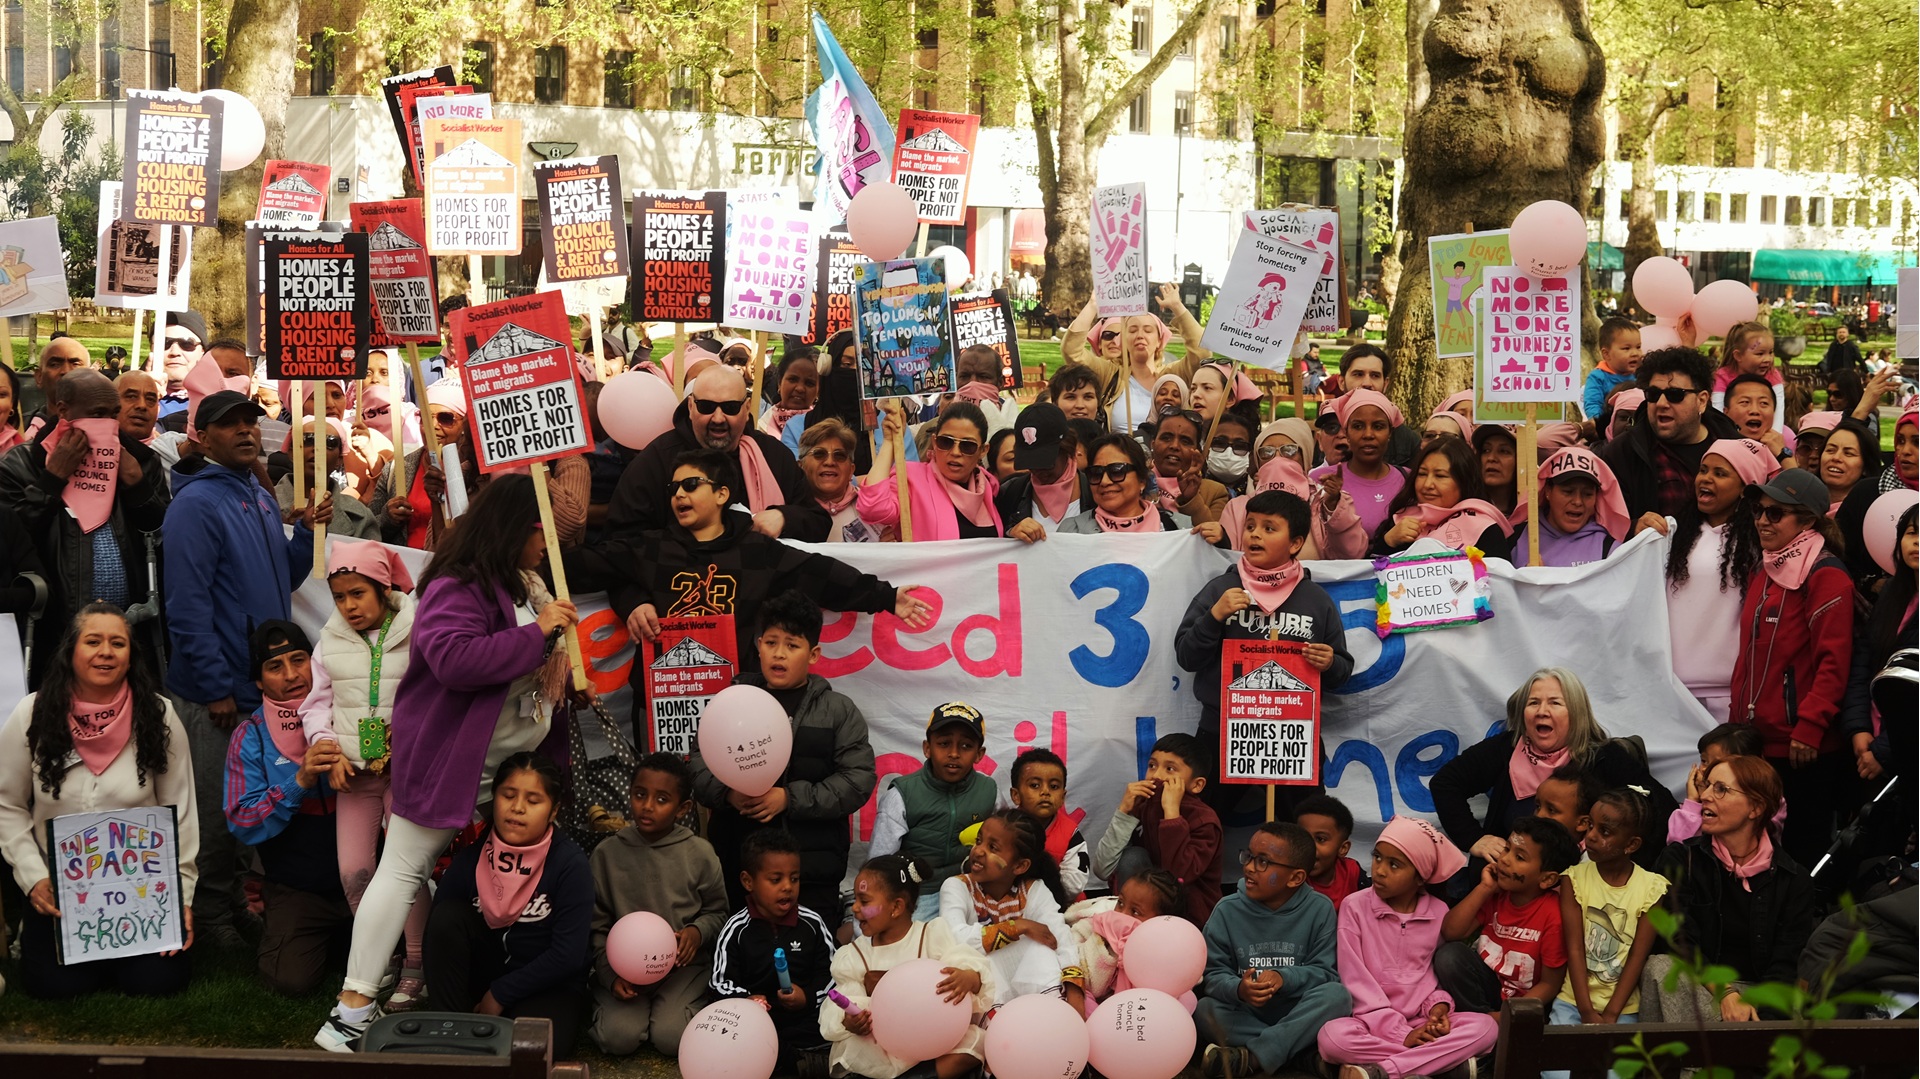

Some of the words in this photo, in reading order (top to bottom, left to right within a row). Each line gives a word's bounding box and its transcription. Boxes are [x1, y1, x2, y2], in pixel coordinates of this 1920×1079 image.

[450, 105, 484, 119] MORE
[140, 114, 196, 133] HOMES
[138, 130, 210, 153] PEOPLE
[137, 150, 164, 162] NOT
[165, 152, 208, 166] PROFIT
[137, 162, 206, 181] COUNCIL
[136, 178, 206, 196] HOUSING
[548, 179, 598, 197] HOMES
[898, 173, 935, 189] HOMES
[939, 178, 958, 190] FOR
[150, 194, 188, 209] RENT
[939, 191, 959, 203] NOT
[1099, 187, 1126, 200] SOCIAL
[436, 199, 478, 212] HOMES
[485, 199, 507, 212] FOR
[550, 192, 612, 214] PEOPLE
[655, 200, 680, 208] Homes
[919, 203, 955, 216] PROFIT
[436, 215, 479, 229] PEOPLE
[487, 215, 510, 229] NOT
[551, 213, 573, 226] NOT
[575, 210, 612, 224] PROFIT
[646, 214, 700, 230] HOMES
[740, 214, 774, 230] NO
[1261, 215, 1307, 225] SOCIAL
[553, 222, 614, 240] COUNCIL
[1264, 224, 1316, 236] HOUSING!
[436, 231, 458, 246] FOR
[466, 231, 508, 246] PROFIT
[554, 236, 616, 254] HOUSING
[645, 229, 712, 249] PEOPLE
[738, 232, 807, 254] MORE
[289, 244, 316, 253] Homes
[645, 249, 669, 260] NOT
[672, 250, 712, 261] PROFIT
[1256, 240, 1274, 252] Stop
[1277, 247, 1307, 265] forcing
[1432, 242, 1464, 264] TOO
[1469, 239, 1506, 266] LONG
[568, 251, 601, 266] RENT
[738, 249, 806, 271] LONG
[1125, 253, 1140, 271] NOT
[1258, 254, 1296, 272] homeless
[279, 259, 340, 276] HOMES
[343, 259, 355, 276] 4
[645, 261, 712, 277] COUNCIL
[645, 277, 711, 292] HOUSING
[734, 268, 806, 289] JOURNEYS
[1114, 269, 1142, 285] SOCIAL
[279, 277, 355, 297] PEOPLE
[373, 282, 404, 298] HOMES
[408, 281, 426, 297] FOR
[1492, 277, 1529, 294] NO
[280, 298, 306, 311] NOT
[309, 298, 355, 311] PROFIT
[658, 292, 694, 306] RENT
[770, 290, 802, 307] TO
[1492, 296, 1569, 312] MORE
[379, 300, 412, 315] PEOPLE
[414, 299, 430, 314] NOT
[280, 312, 355, 329] COUNCIL
[383, 317, 399, 332] FOR
[401, 316, 432, 332] PROFIT
[861, 311, 890, 326] TOO
[892, 308, 924, 322] LONG
[954, 308, 994, 325] HOMES
[1494, 316, 1570, 333] LONG
[281, 330, 356, 345] HOUSING
[956, 319, 1006, 340] PEOPLE
[1220, 322, 1252, 339] families
[1255, 334, 1269, 345] out
[1272, 338, 1282, 348] of
[1230, 338, 1264, 354] London!
[1492, 336, 1572, 353] JOURNEYS
[296, 347, 337, 362] RENT
[471, 366, 500, 381] Blame
[502, 362, 518, 373] the
[1534, 356, 1570, 372] TO
[474, 382, 490, 394] not
[493, 373, 534, 390] migrants
[479, 394, 532, 420] HOMES
[537, 387, 567, 408] FOR
[483, 412, 540, 440] PEOPLE
[545, 405, 574, 428] NOT
[487, 439, 518, 460] FOR
[523, 426, 575, 453] PROFIT
[1550, 454, 1598, 477] HASL
[74, 470, 110, 481] COUNCIL
[74, 481, 106, 492] HOMES
[1269, 482, 1285, 490] FOR
[1773, 548, 1802, 569] HOMES
[1386, 564, 1453, 582] CHILDREN
[1406, 584, 1442, 599] NEED
[1402, 602, 1451, 618] HOMES
[1240, 644, 1274, 654] Socialist
[654, 671, 677, 682] Blame
[670, 683, 703, 694] migrants
[1231, 693, 1255, 704] Blame
[1259, 694, 1271, 704] the
[1274, 694, 1303, 706] market,
[95, 710, 115, 721] FOR
[656, 700, 699, 717] HOMES
[1231, 706, 1244, 715] not
[1248, 706, 1282, 717] migrants
[1231, 723, 1276, 739] HOMES
[1281, 724, 1304, 740] FOR
[659, 736, 683, 751] FOR
[758, 735, 772, 747] bed
[734, 750, 767, 763] council
[1231, 741, 1278, 757] PEOPLE
[1283, 742, 1307, 758] NOT
[739, 760, 767, 771] homes
[1230, 758, 1256, 774] FOR
[1261, 759, 1305, 776] PROFIT
[61, 827, 99, 858] WE
[109, 822, 164, 849] NEED
[64, 849, 162, 880] SPACE
[103, 891, 126, 906] TO
[74, 911, 166, 953] GROW
[1249, 957, 1295, 967] SPORTING
[708, 1015, 738, 1027] council
[714, 1008, 741, 1020] homes
[1116, 1003, 1125, 1030] homes
[1137, 1025, 1146, 1041] bed
